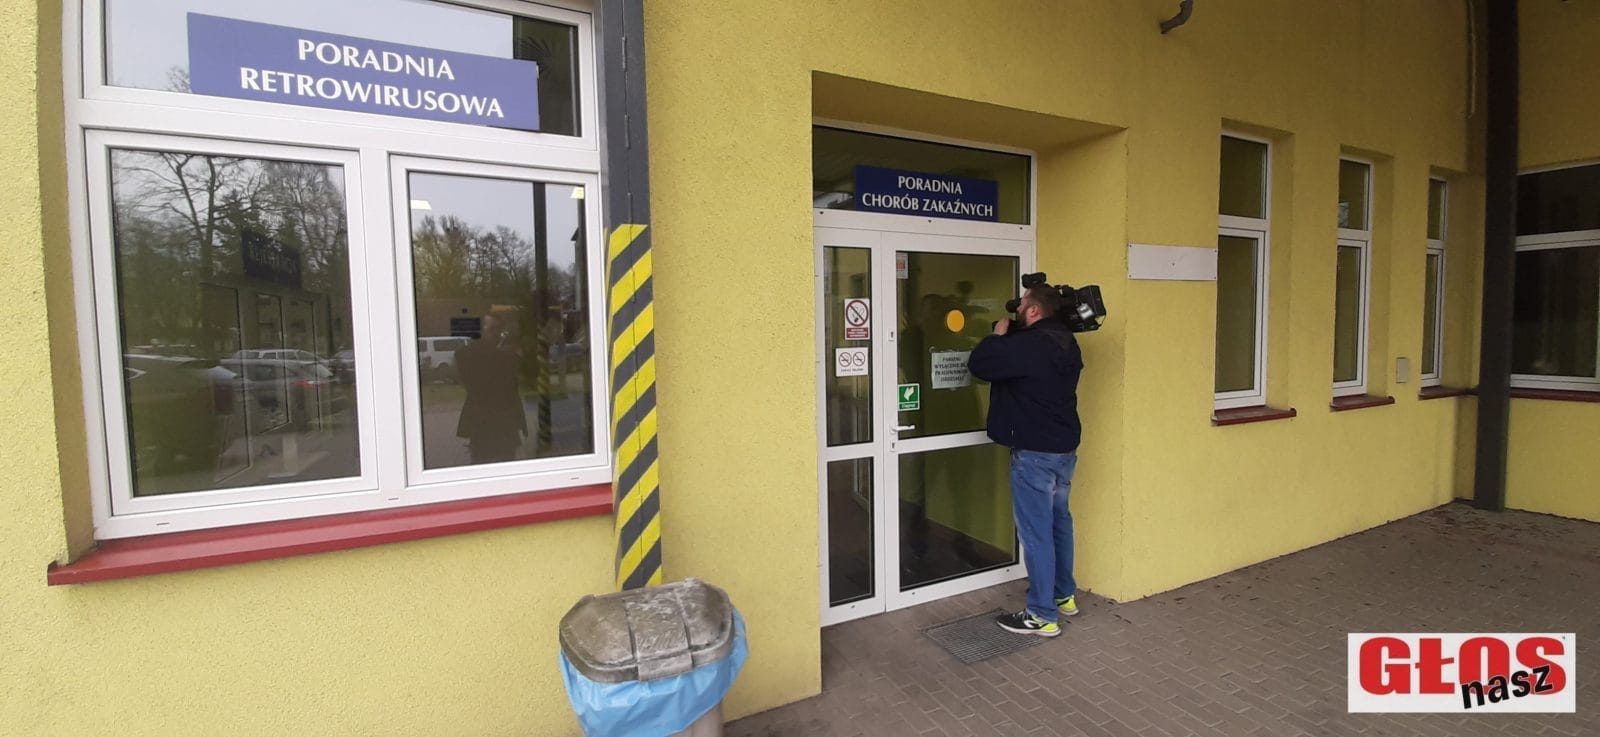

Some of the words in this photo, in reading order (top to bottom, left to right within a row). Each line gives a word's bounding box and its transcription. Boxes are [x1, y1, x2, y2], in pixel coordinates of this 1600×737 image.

[298, 38, 455, 81] PORADNIA
[239, 66, 504, 118] RETROWIRUSOWA
[898, 175, 963, 195] PORADNIA
[862, 193, 919, 211] CHORÓB
[922, 199, 993, 217] ZAKAŹNYCH
